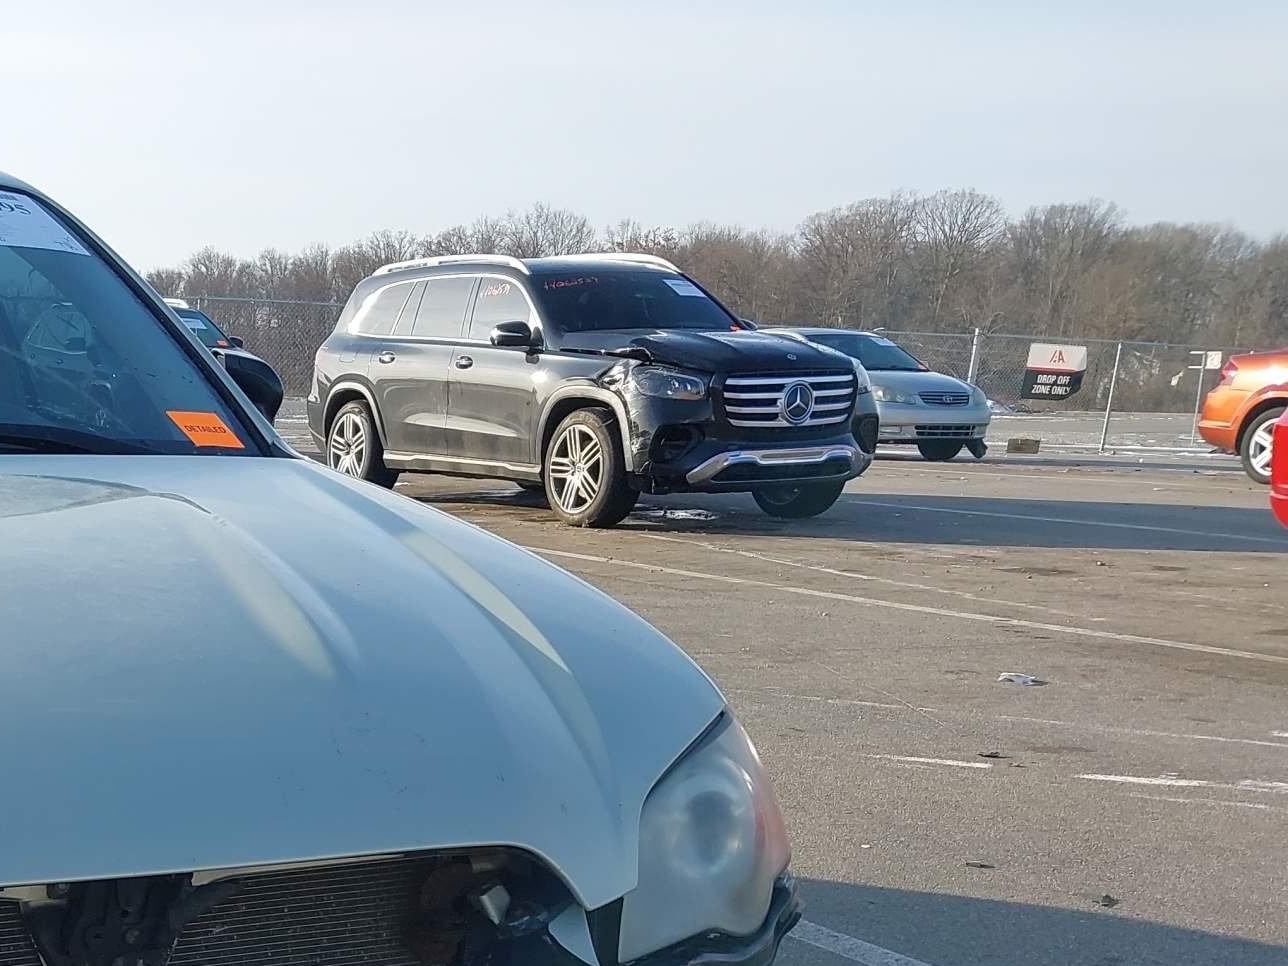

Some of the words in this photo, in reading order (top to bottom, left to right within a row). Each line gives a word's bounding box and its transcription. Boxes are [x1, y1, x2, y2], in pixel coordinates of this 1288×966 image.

[1037, 374, 1057, 384] DROP
[1057, 375, 1071, 385] OFF
[1031, 385, 1051, 394] ZONE
[1051, 385, 1072, 395] ONLY
[184, 425, 228, 434] DETAILED
